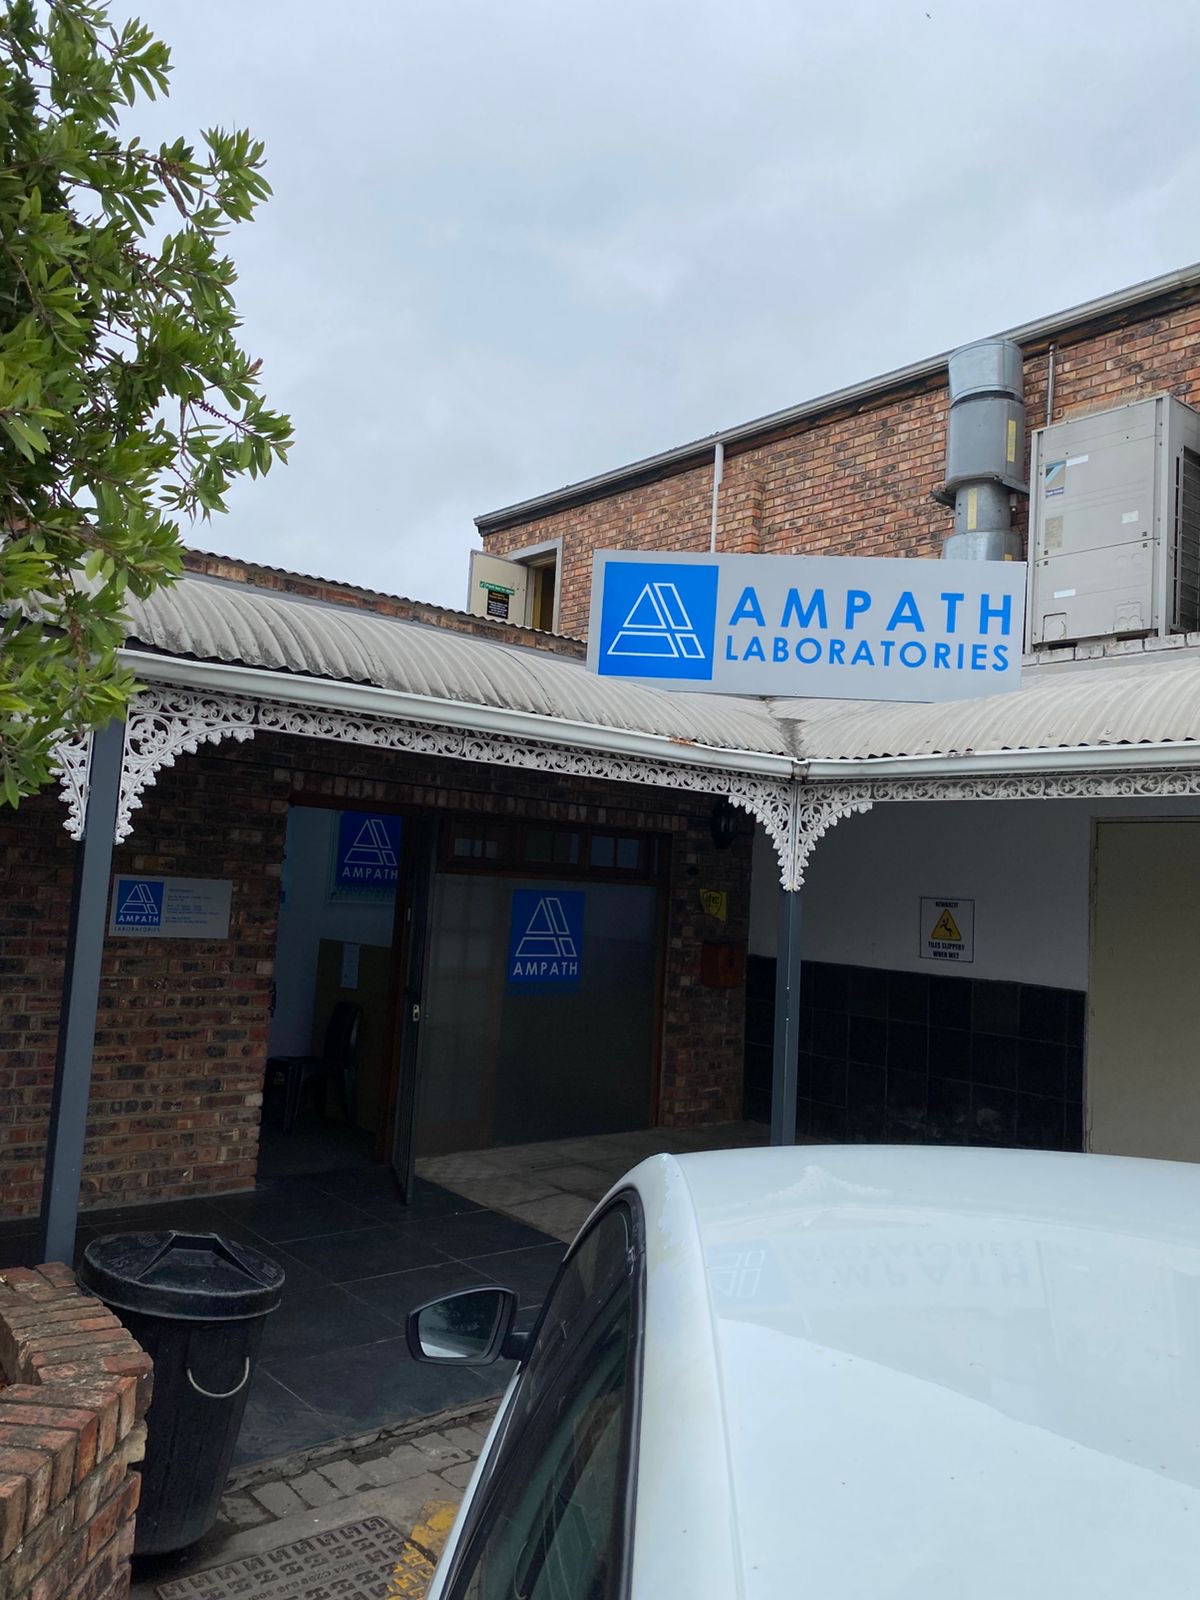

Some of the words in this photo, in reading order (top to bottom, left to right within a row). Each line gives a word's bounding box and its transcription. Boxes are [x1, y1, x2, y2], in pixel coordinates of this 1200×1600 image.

[728, 586, 1011, 635] AMPATH
[726, 634, 1009, 671] LABORATORIES
[342, 866, 398, 880] AMPATH
[118, 915, 159, 923] AMPATH
[512, 961, 578, 976] AMPATH
